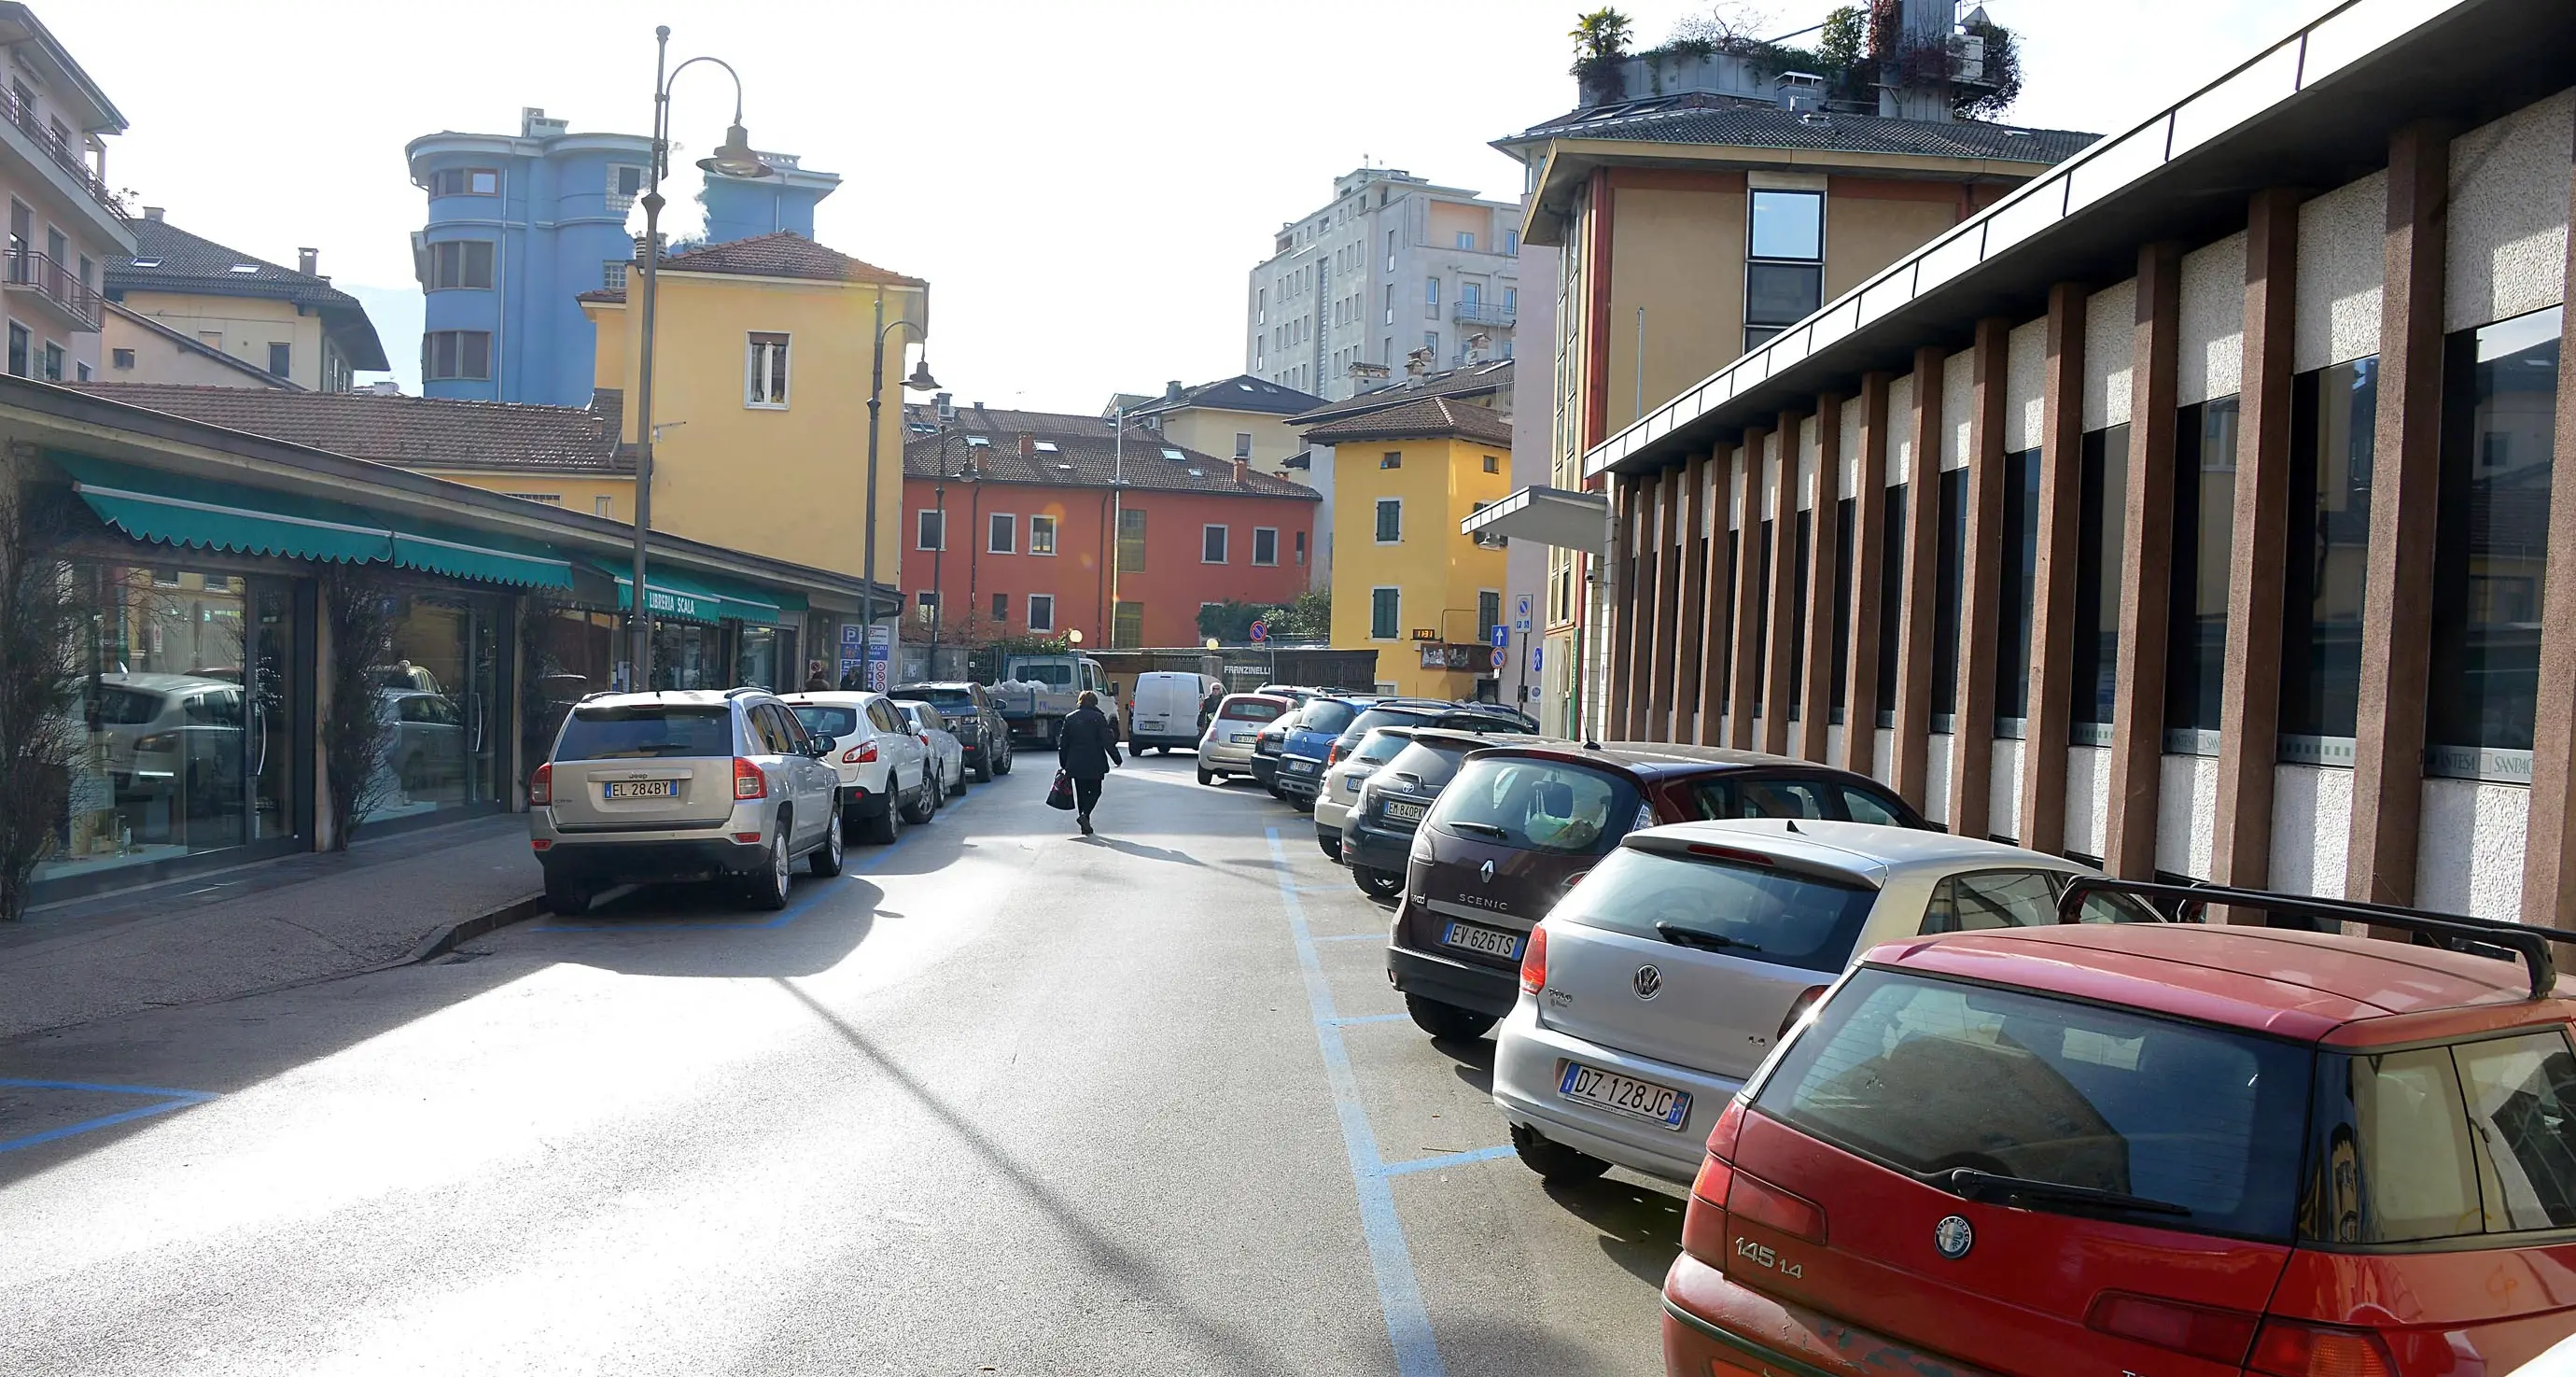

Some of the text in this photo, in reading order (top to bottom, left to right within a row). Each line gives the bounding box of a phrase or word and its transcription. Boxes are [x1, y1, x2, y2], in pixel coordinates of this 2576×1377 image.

[650, 592, 695, 615] LIBRERIA SCALA
[847, 630, 857, 641] P
[1224, 666, 1271, 675] FRANZINELLI
[2441, 752, 2476, 771] INTESA
[612, 783, 628, 796] EL
[632, 781, 669, 796] 284BY
[1389, 803, 1424, 820] EM 840PK
[1459, 893, 1508, 910] SCENIC
[1451, 925, 1469, 944] EV
[1470, 929, 1514, 955] 626TS
[1574, 1068, 1604, 1099] DZ
[1607, 1076, 1673, 1117] 128JC
[1735, 1237, 1803, 1279] 145 1.4
